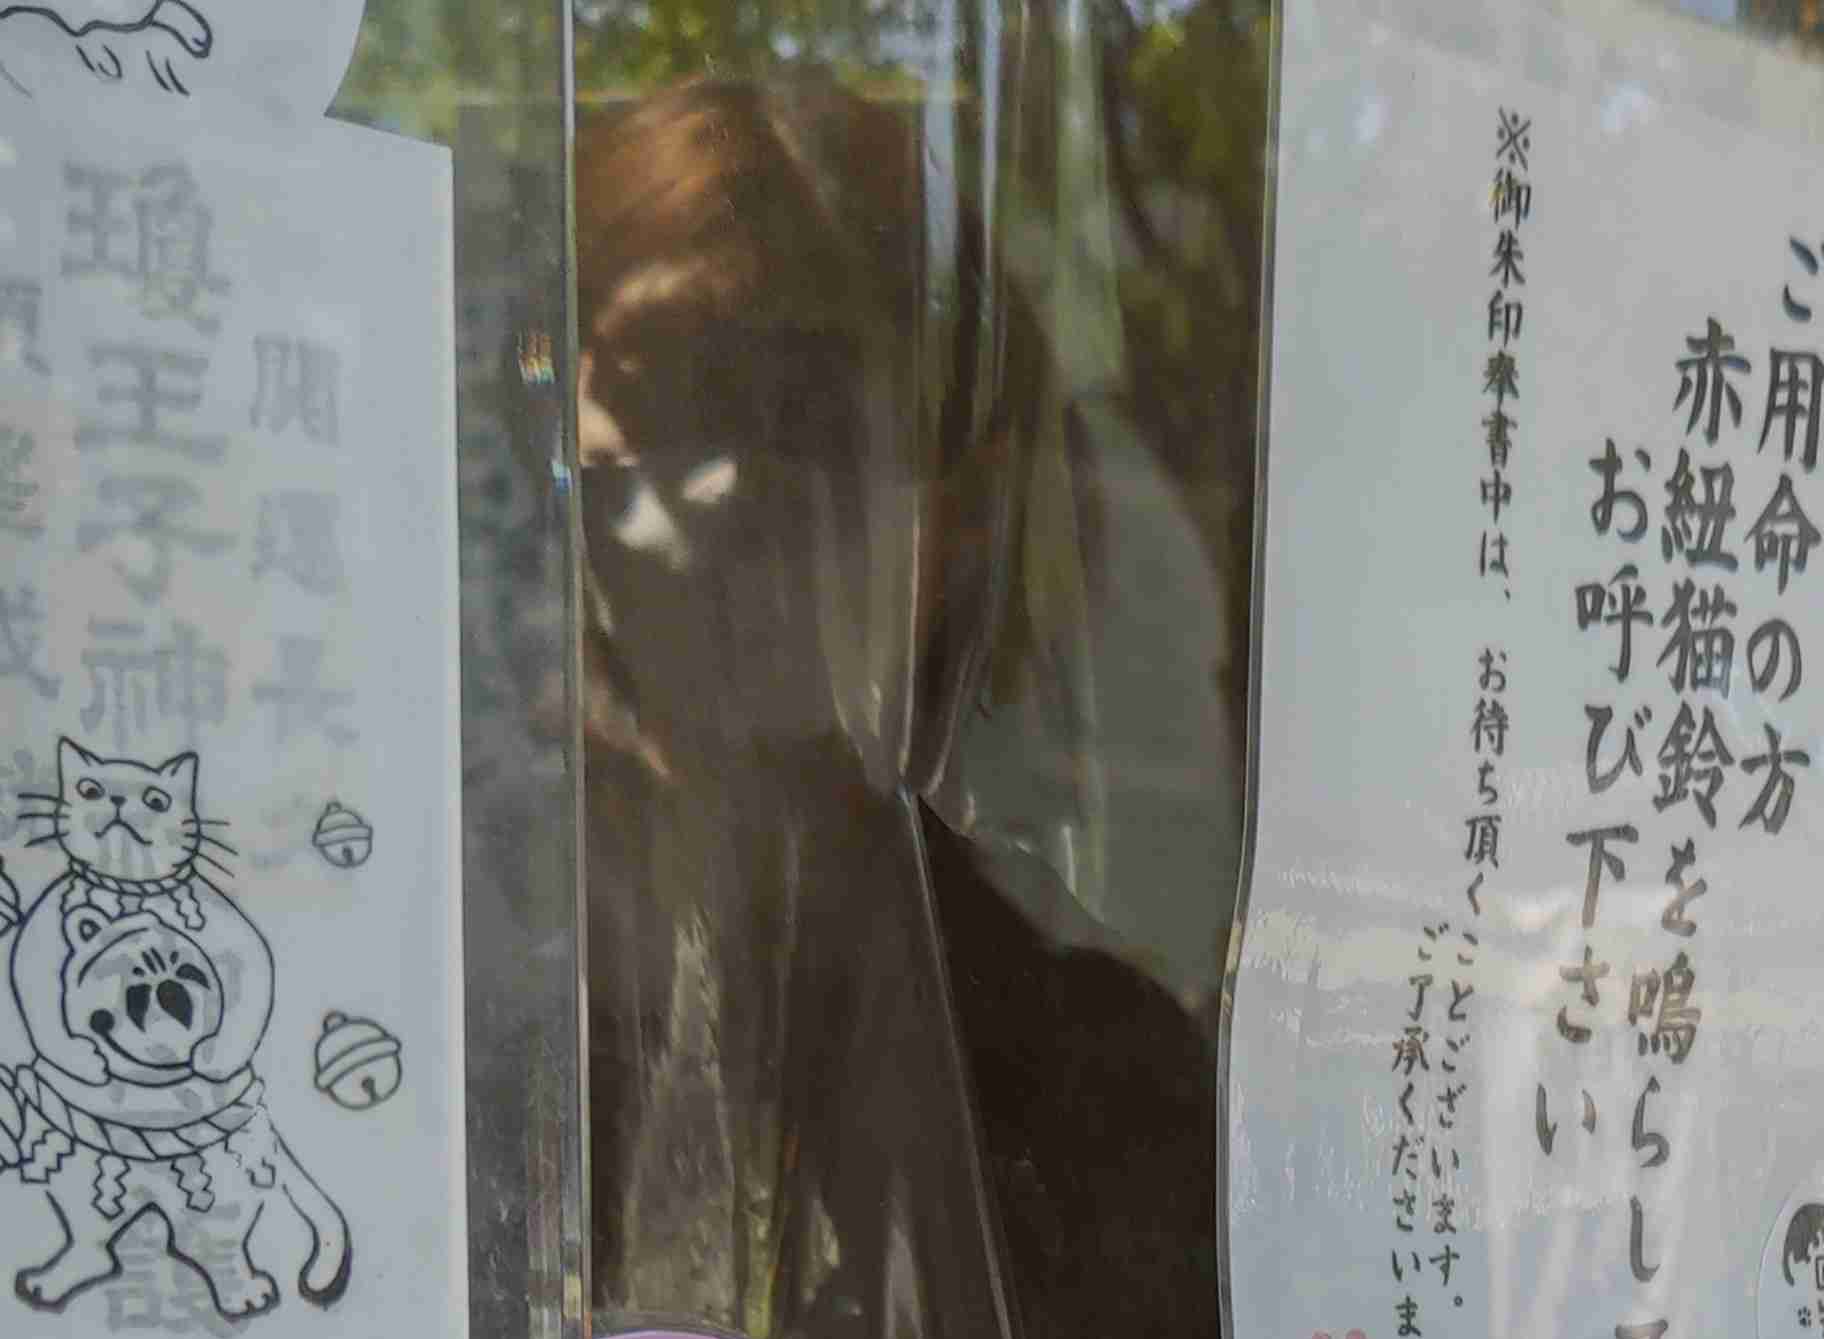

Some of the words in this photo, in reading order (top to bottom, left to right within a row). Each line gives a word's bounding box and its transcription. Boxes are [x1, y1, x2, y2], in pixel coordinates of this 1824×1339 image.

[1478, 104, 1533, 601] ※御朱印奉書中は、
[1537, 436, 1654, 1156] お呼び下さい
